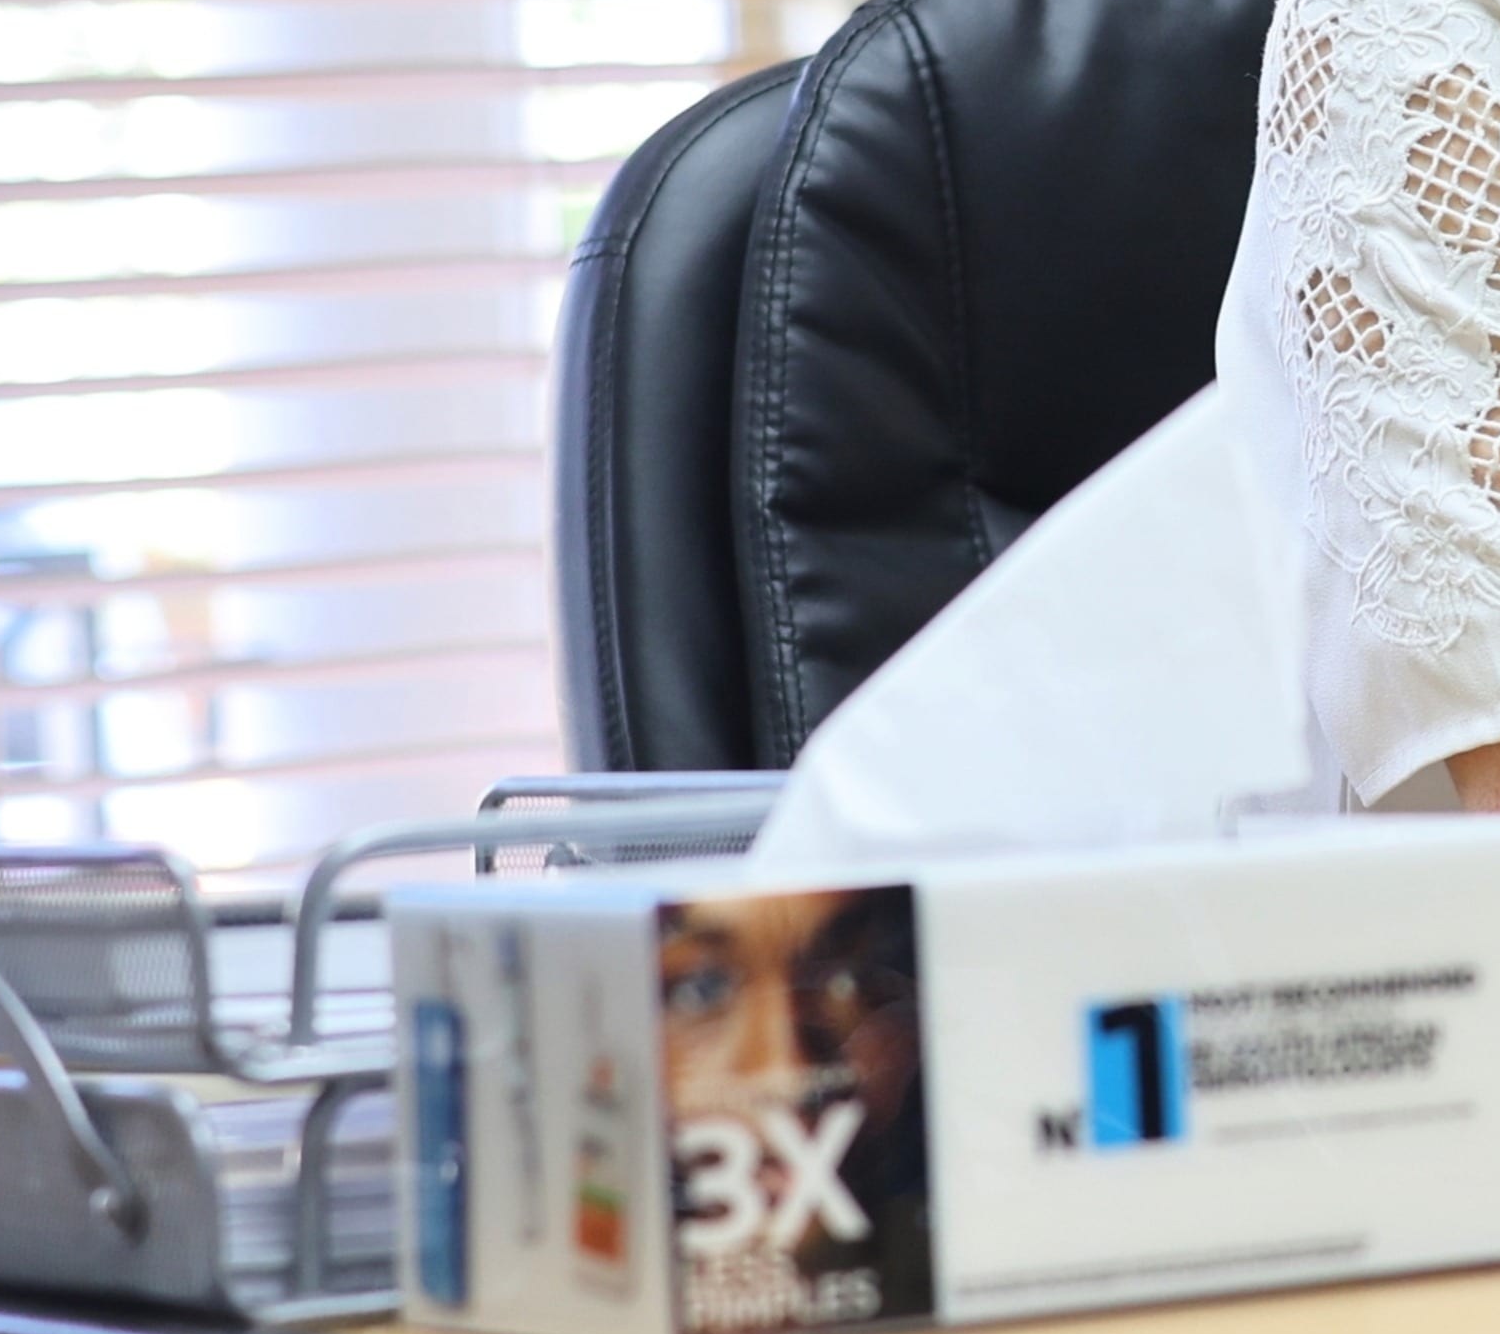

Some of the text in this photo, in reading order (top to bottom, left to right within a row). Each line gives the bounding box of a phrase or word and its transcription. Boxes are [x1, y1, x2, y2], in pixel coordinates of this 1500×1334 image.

[677, 1103, 870, 1249] 3X
[682, 1247, 792, 1292] LESS
[683, 1271, 880, 1330] PIMPLES
